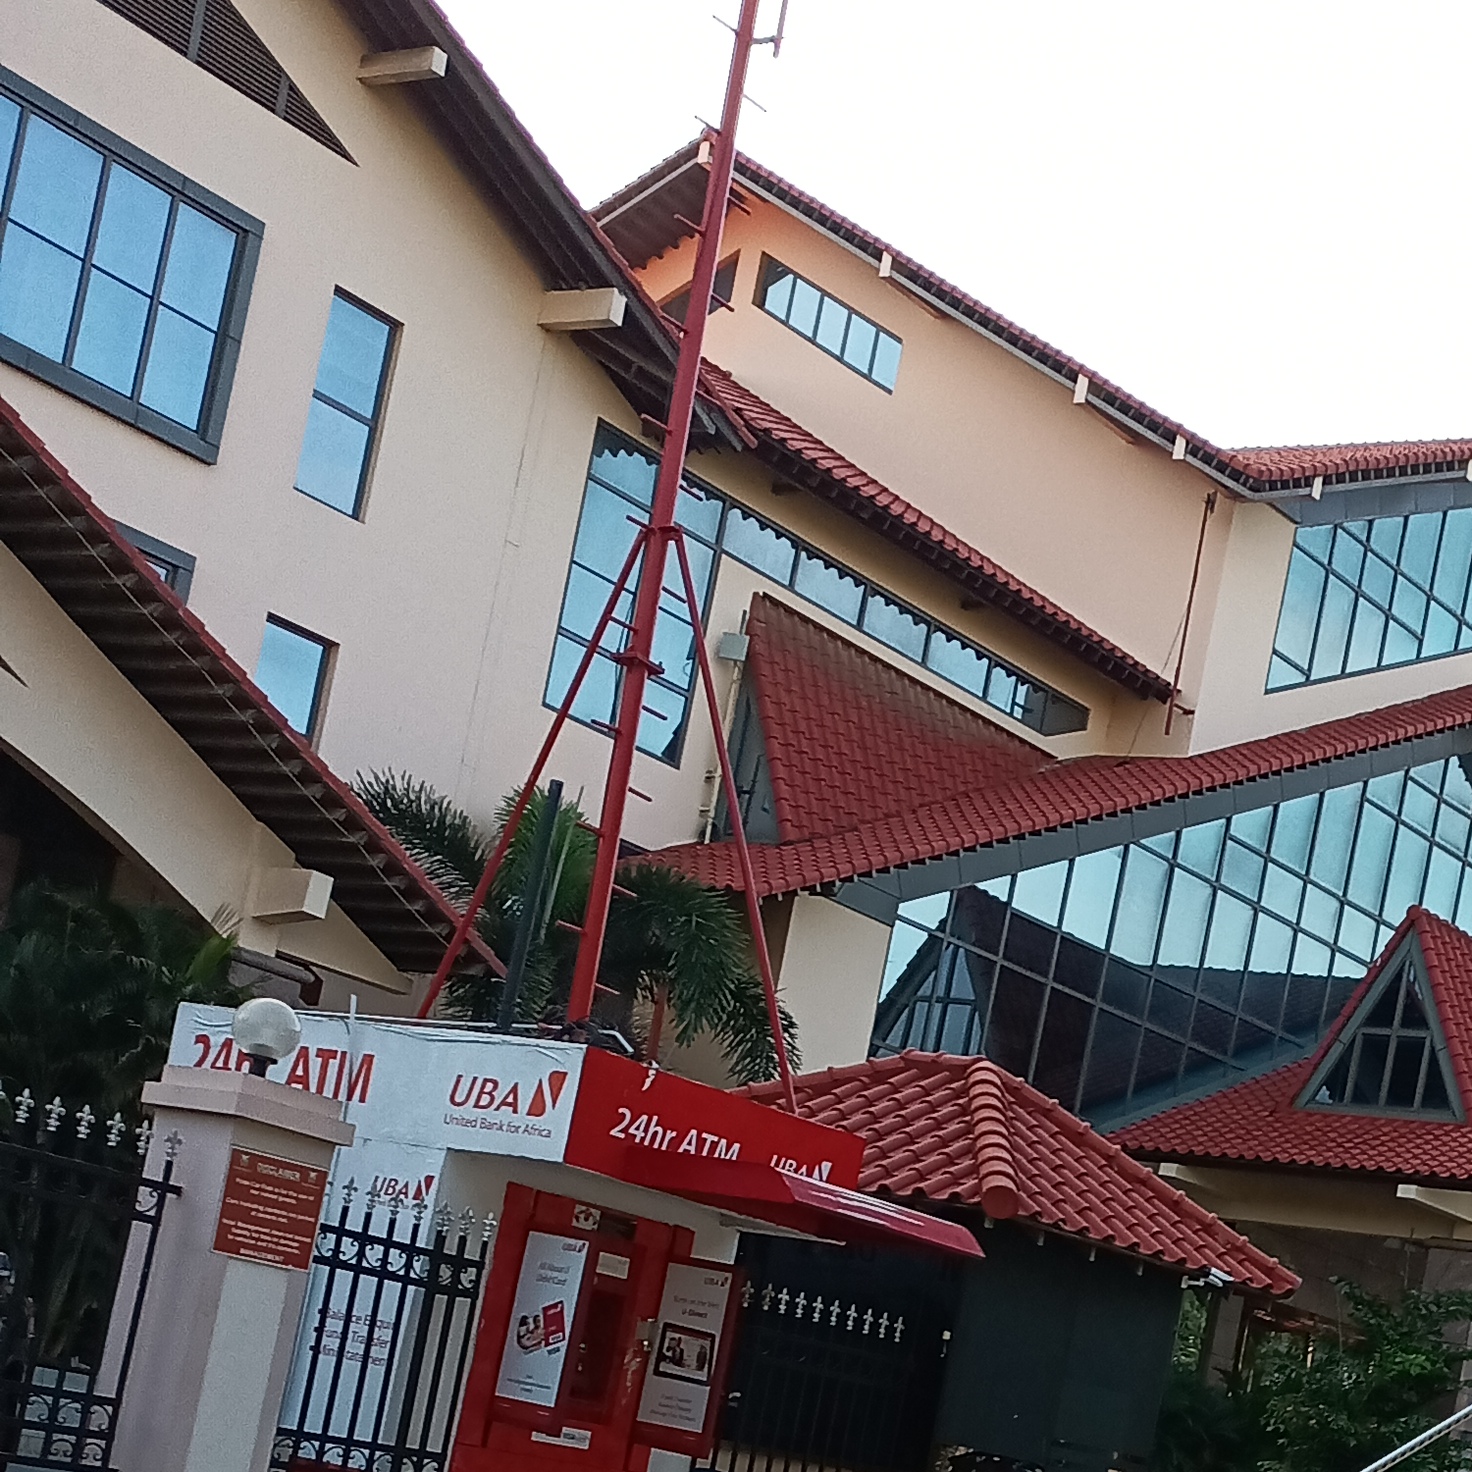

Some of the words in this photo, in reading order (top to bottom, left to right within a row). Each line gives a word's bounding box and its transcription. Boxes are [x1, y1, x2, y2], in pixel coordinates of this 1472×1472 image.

[285, 1045, 375, 1104] ATM
[449, 1074, 519, 1114] UBA
[443, 1113, 478, 1128] United
[479, 1117, 504, 1132] Bank
[506, 1121, 522, 1134] for
[522, 1123, 552, 1138] Africa
[609, 1107, 677, 1152] 24hr
[677, 1129, 741, 1161] ATM
